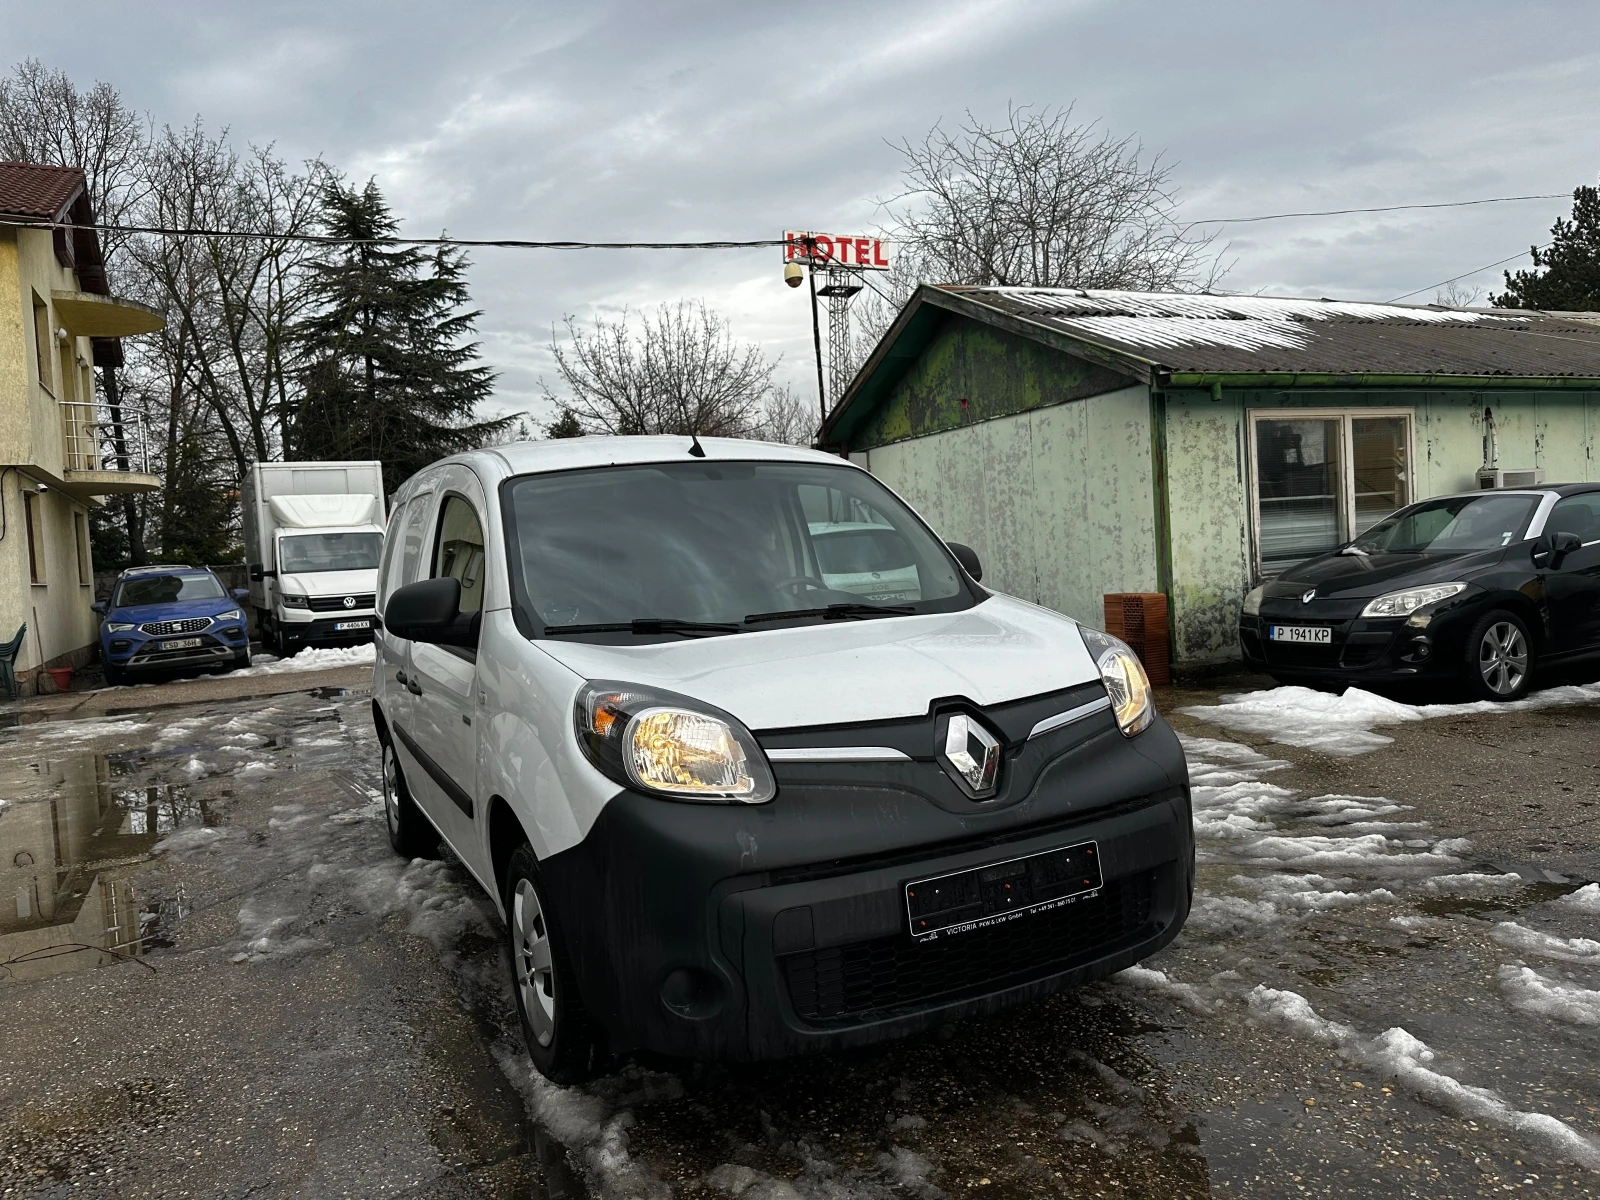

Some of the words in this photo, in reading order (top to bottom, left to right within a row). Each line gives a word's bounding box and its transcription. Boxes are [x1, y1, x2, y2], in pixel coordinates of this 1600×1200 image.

[787, 233, 888, 266] HOTEL
[1278, 628, 1284, 640] P
[946, 922, 977, 935] VICTORIA
[979, 920, 990, 928] PKW
[996, 916, 1007, 924] LKW
[1008, 912, 1023, 921] GmbH
